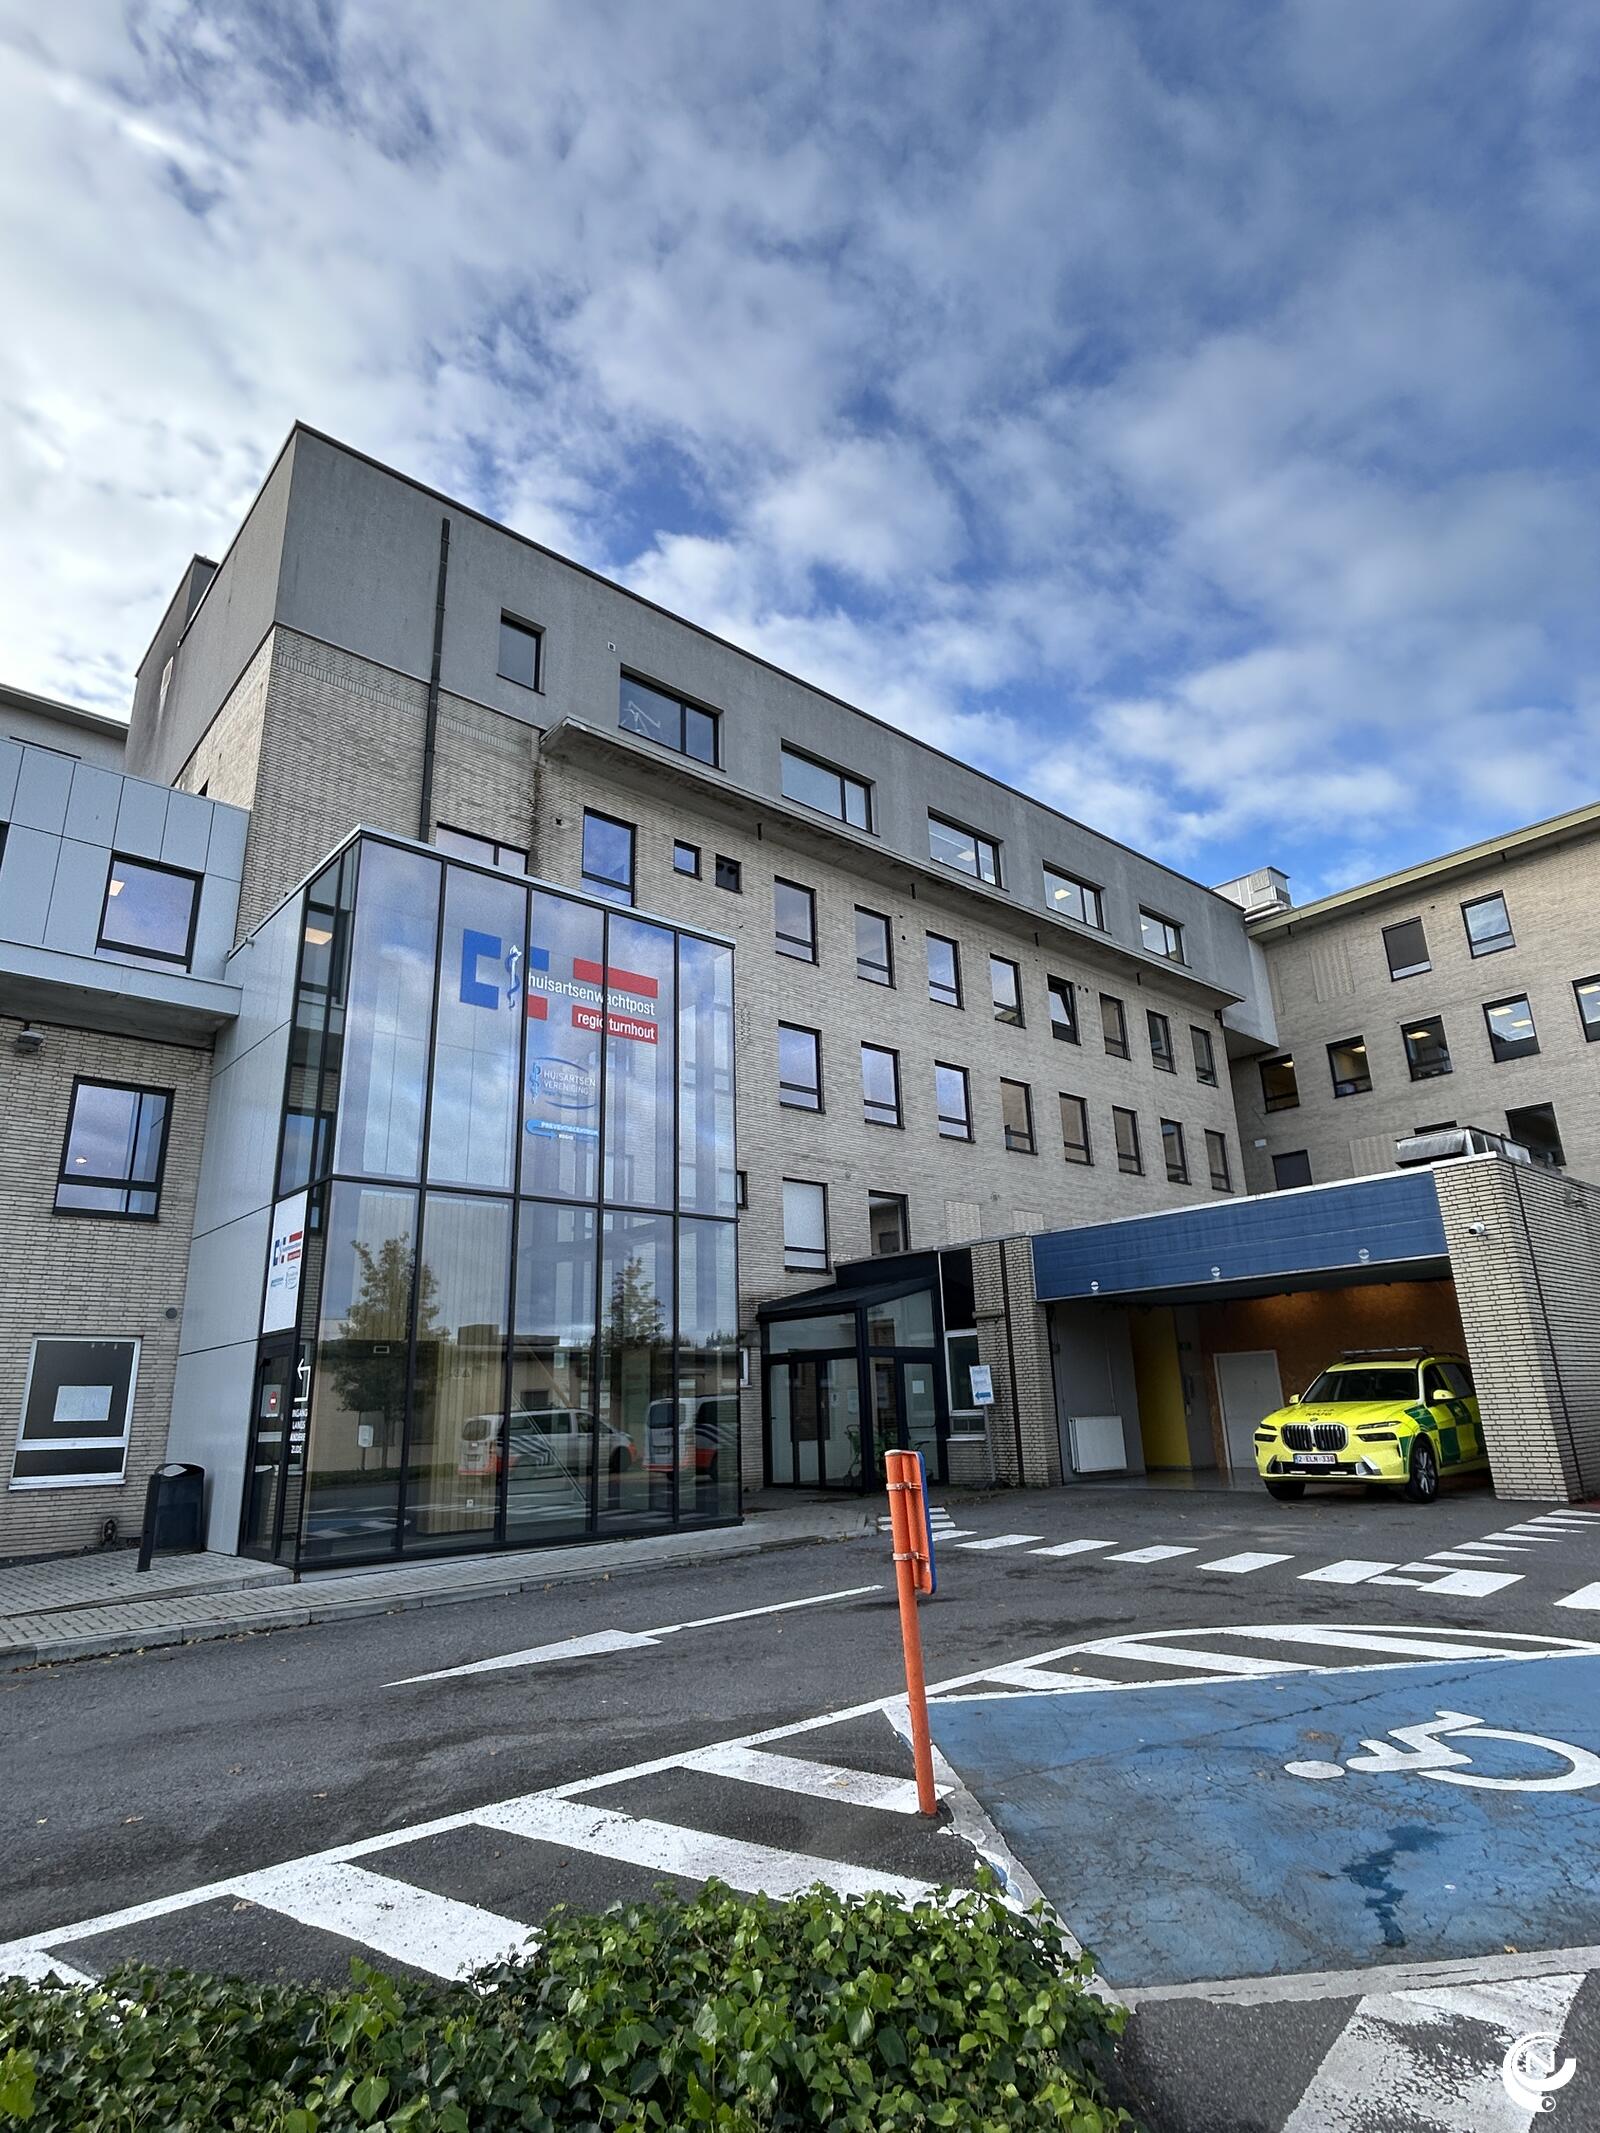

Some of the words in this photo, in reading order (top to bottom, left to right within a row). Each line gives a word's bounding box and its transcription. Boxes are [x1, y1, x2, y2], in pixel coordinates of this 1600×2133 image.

[528, 971, 656, 1016] huisartsenwachtpost
[608, 1018, 656, 1040] turnhout
[543, 1070, 596, 1087] HUISARTSEN
[543, 1080, 590, 1097] VERENIGING
